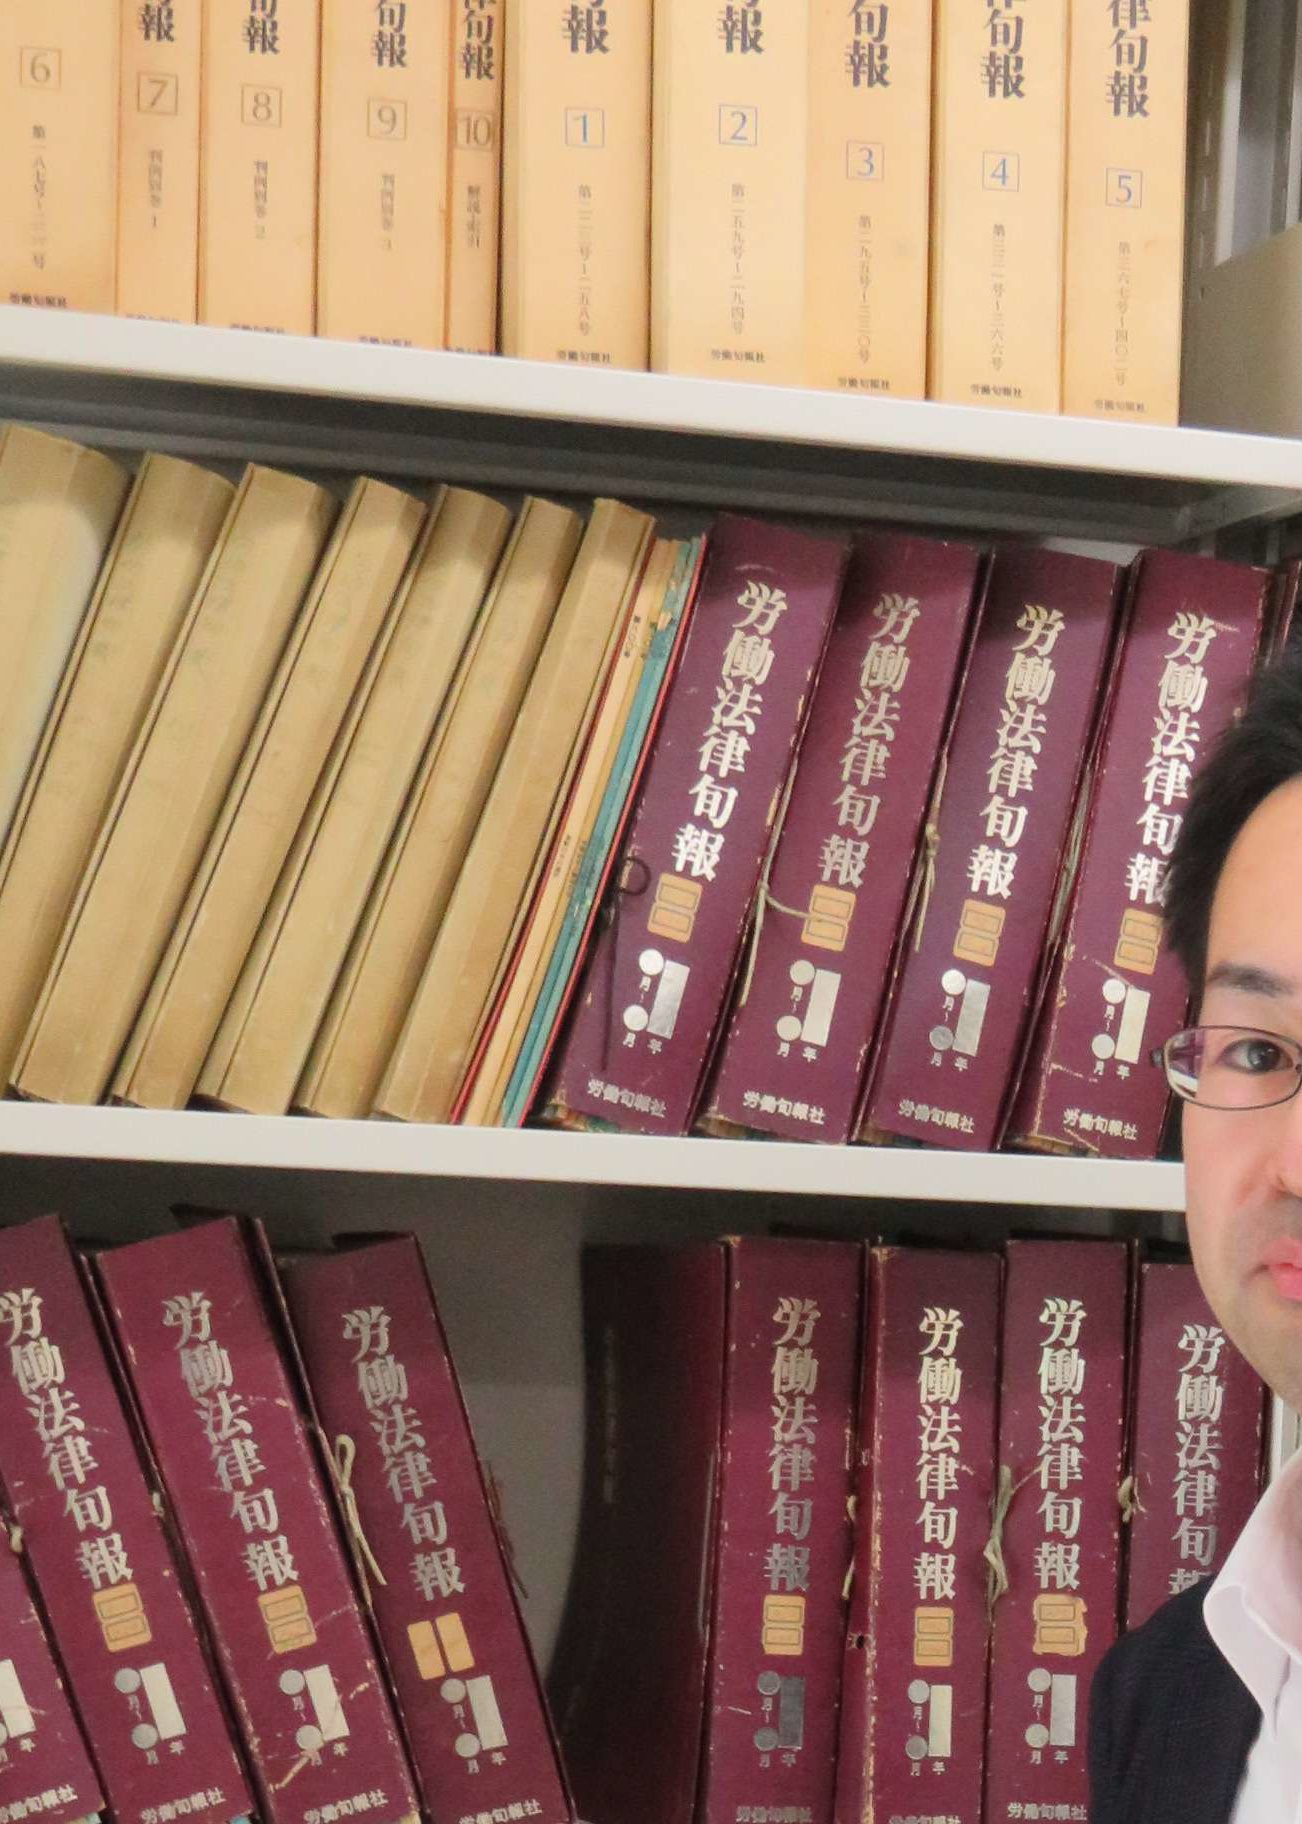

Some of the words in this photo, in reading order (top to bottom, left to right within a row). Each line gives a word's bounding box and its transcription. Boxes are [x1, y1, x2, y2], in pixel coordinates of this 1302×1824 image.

[139, 0, 174, 42] 報
[460, 0, 495, 80] 旬報
[562, 0, 610, 54] 報
[717, 0, 764, 54] 報
[844, 0, 890, 88] 旬報
[980, 0, 1026, 98] 旬報
[670, 580, 788, 882] 労働法律旬報
[818, 594, 920, 889] 労働法律旬報
[966, 604, 1066, 900] 労働法律旬報
[587, 1078, 667, 1118] 労働旬報社
[743, 1090, 826, 1125] 労働旬報社
[898, 1099, 975, 1134] 労働旬報社
[1063, 1107, 1138, 1141] 労働旬報社
[0, 1286, 134, 1589] 労働法律旬報
[163, 1290, 300, 1590] 労働法律旬報
[341, 1305, 465, 1601] 労働法律旬報
[762, 1297, 822, 1592] 労働法律旬報
[912, 1306, 963, 1601] 労働法律旬報
[1032, 1297, 1087, 1592] 労働法律旬報
[736, 1806, 813, 1823] 労働旬報社
[1007, 1802, 1087, 1821] 労働旬報社
